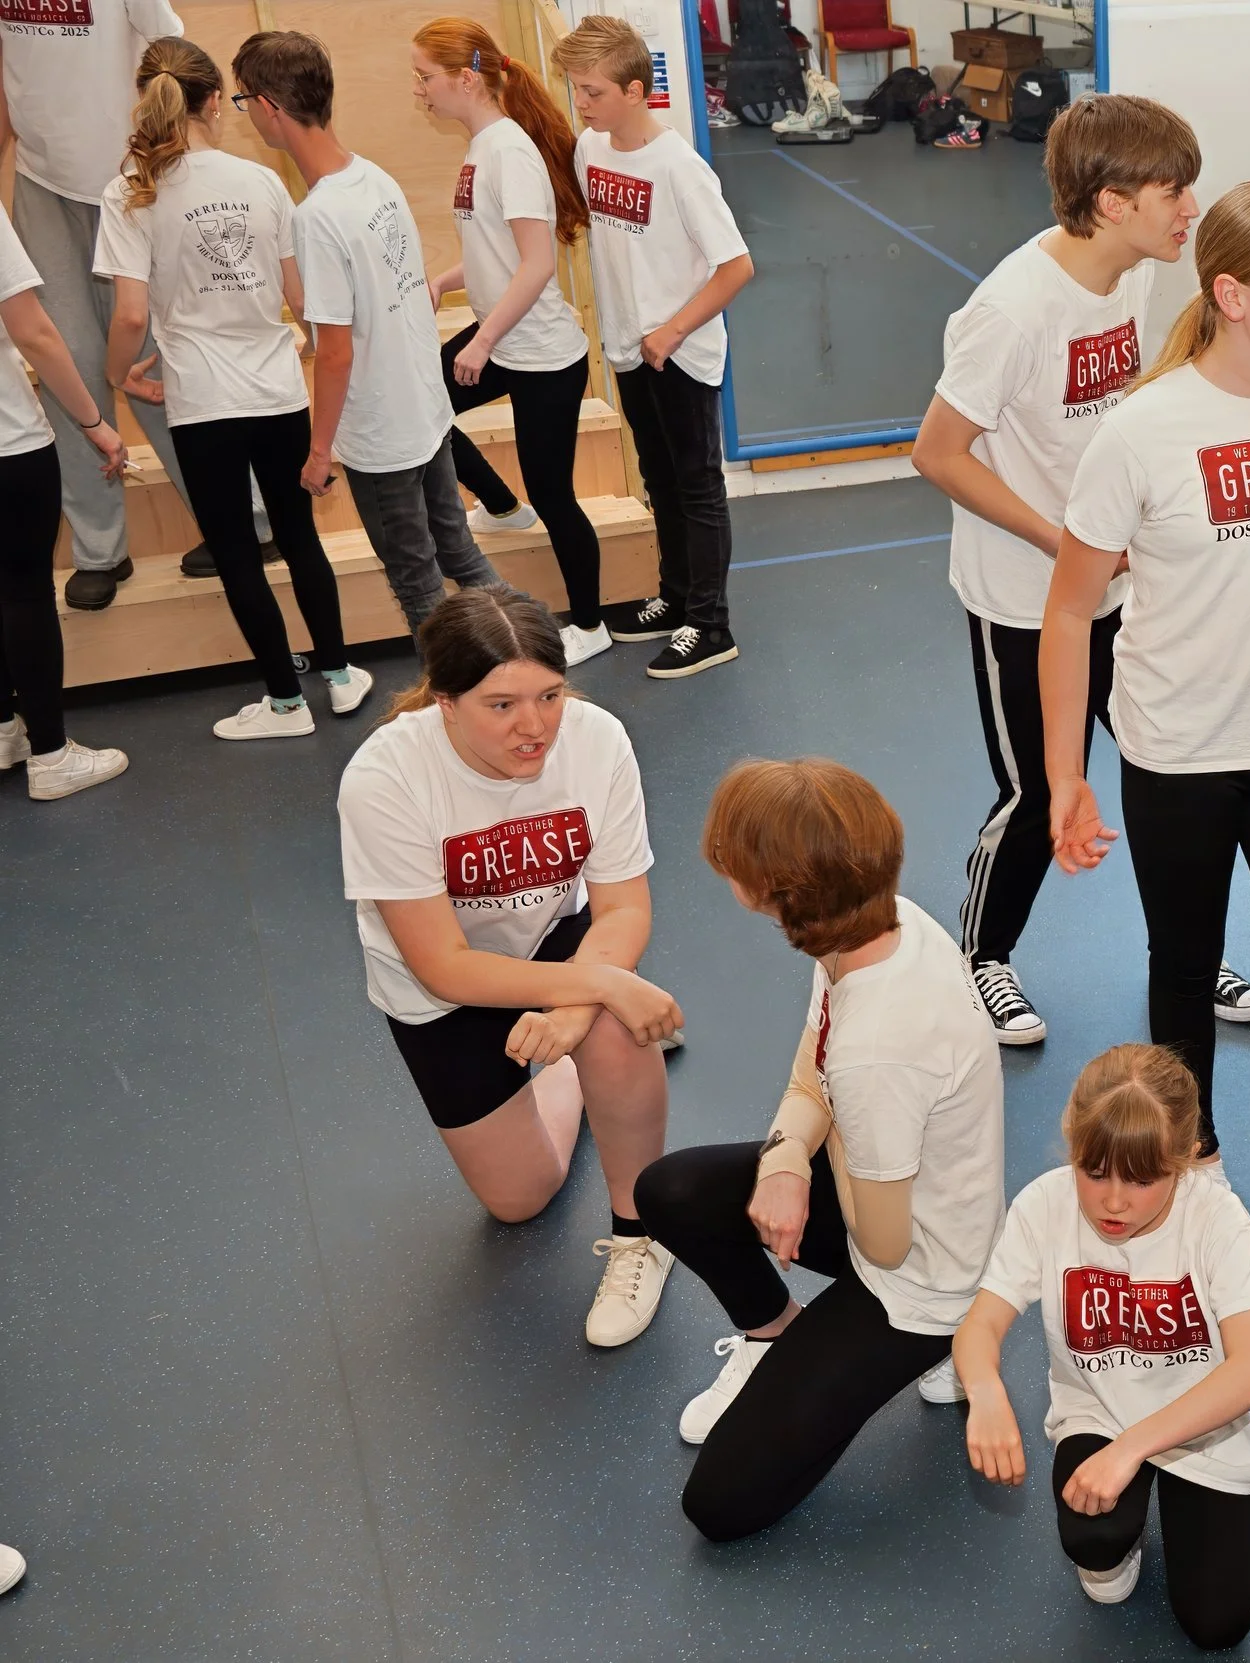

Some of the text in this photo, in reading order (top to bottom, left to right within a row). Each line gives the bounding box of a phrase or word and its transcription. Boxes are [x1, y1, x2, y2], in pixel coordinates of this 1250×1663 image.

[60, 26, 90, 37] 2025
[590, 178, 646, 213] GREASE
[184, 202, 250, 222] DEREHAM
[196, 234, 255, 268] THEATRE COMPANY
[211, 270, 256, 281] DOSYTCo
[1233, 447, 1248, 459] WE
[1227, 506, 1236, 517] 19
[476, 833, 491, 846] WE
[503, 818, 554, 836] TOGETHER
[461, 827, 584, 884] GREASE
[482, 883, 503, 894] THE
[509, 869, 564, 888] MUSICAL
[453, 882, 571, 910] DOSYTCo 20
[1088, 1273, 1169, 1300] WE GO GETHER
[1081, 1288, 1200, 1336] GREASE
[1082, 1336, 1094, 1347] 19
[1122, 1331, 1178, 1349] MUSICAL
[1191, 1331, 1203, 1342] 59
[1073, 1348, 1210, 1373] DOSYTCo 2025
